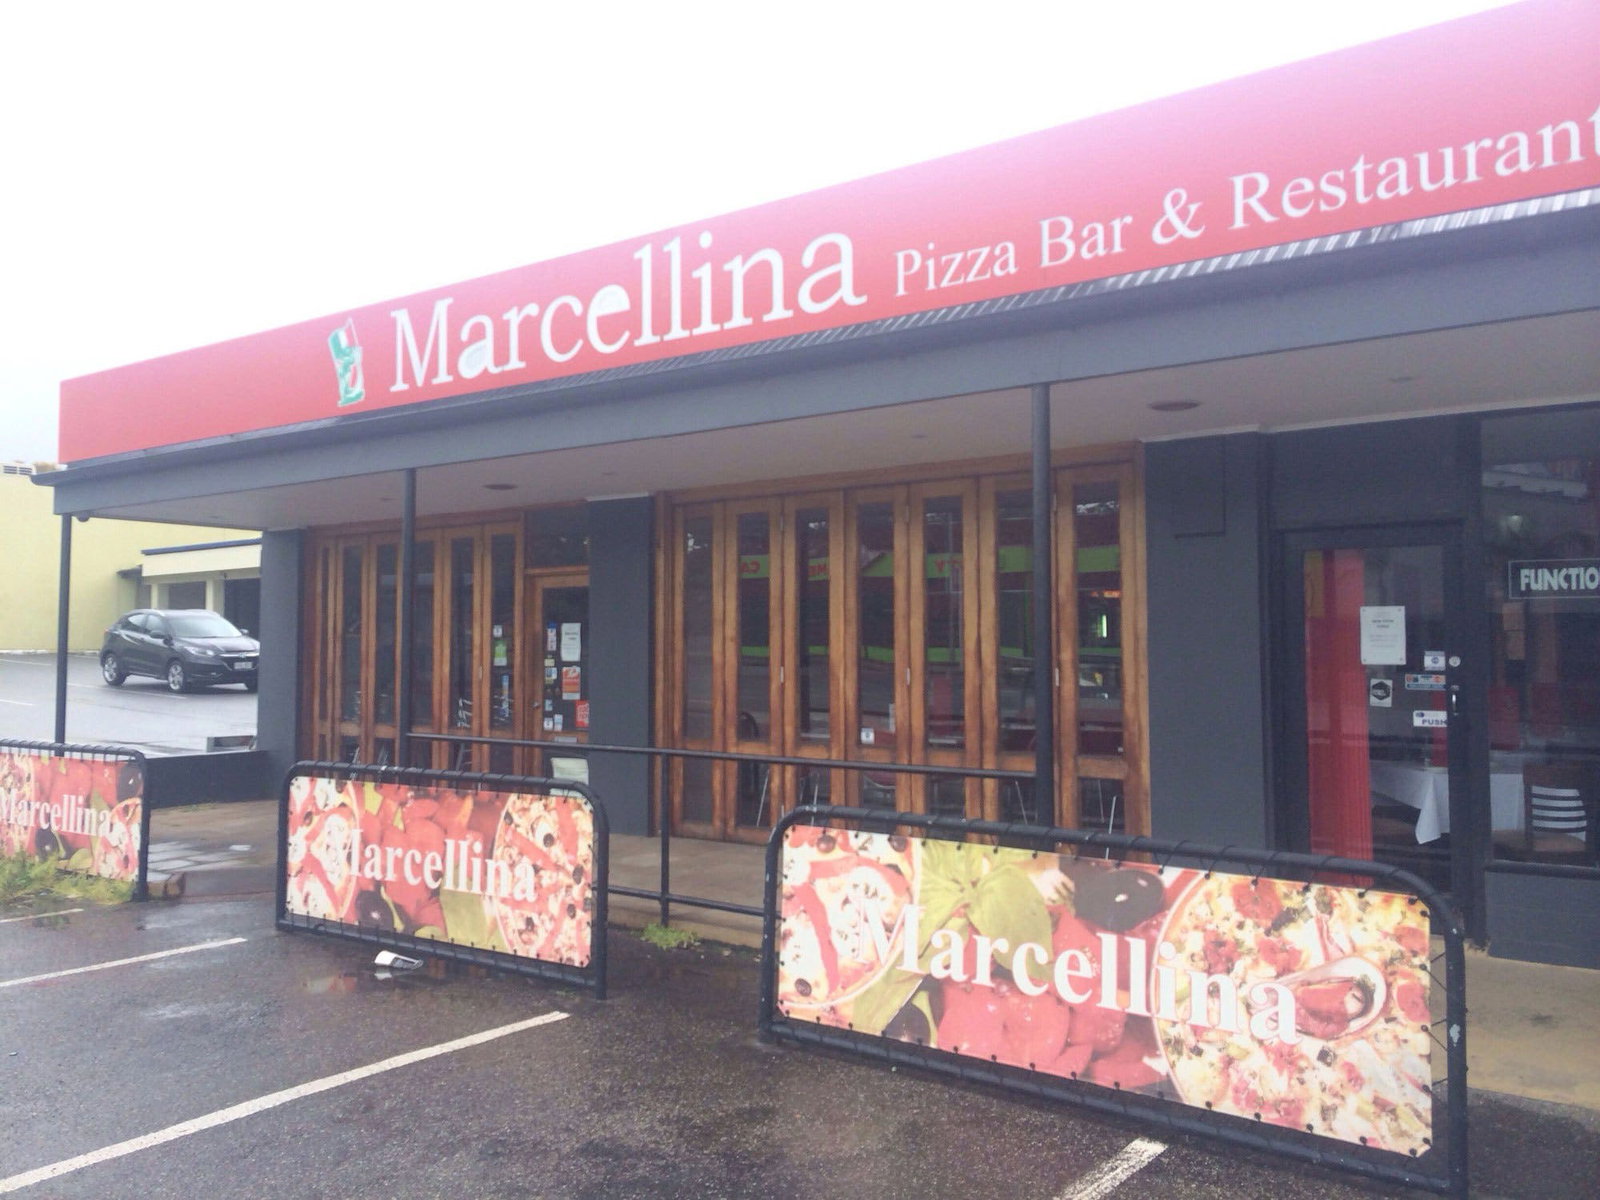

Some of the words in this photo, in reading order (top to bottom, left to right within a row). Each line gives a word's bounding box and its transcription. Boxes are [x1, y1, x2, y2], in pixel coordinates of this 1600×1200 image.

[893, 241, 1018, 298] Pizza
[1039, 213, 1133, 268] Bar
[1151, 187, 1205, 246] &
[1229, 105, 1600, 230] Restaurant
[390, 231, 867, 392] Marcellina
[852, 896, 1300, 1047] Marcellina
